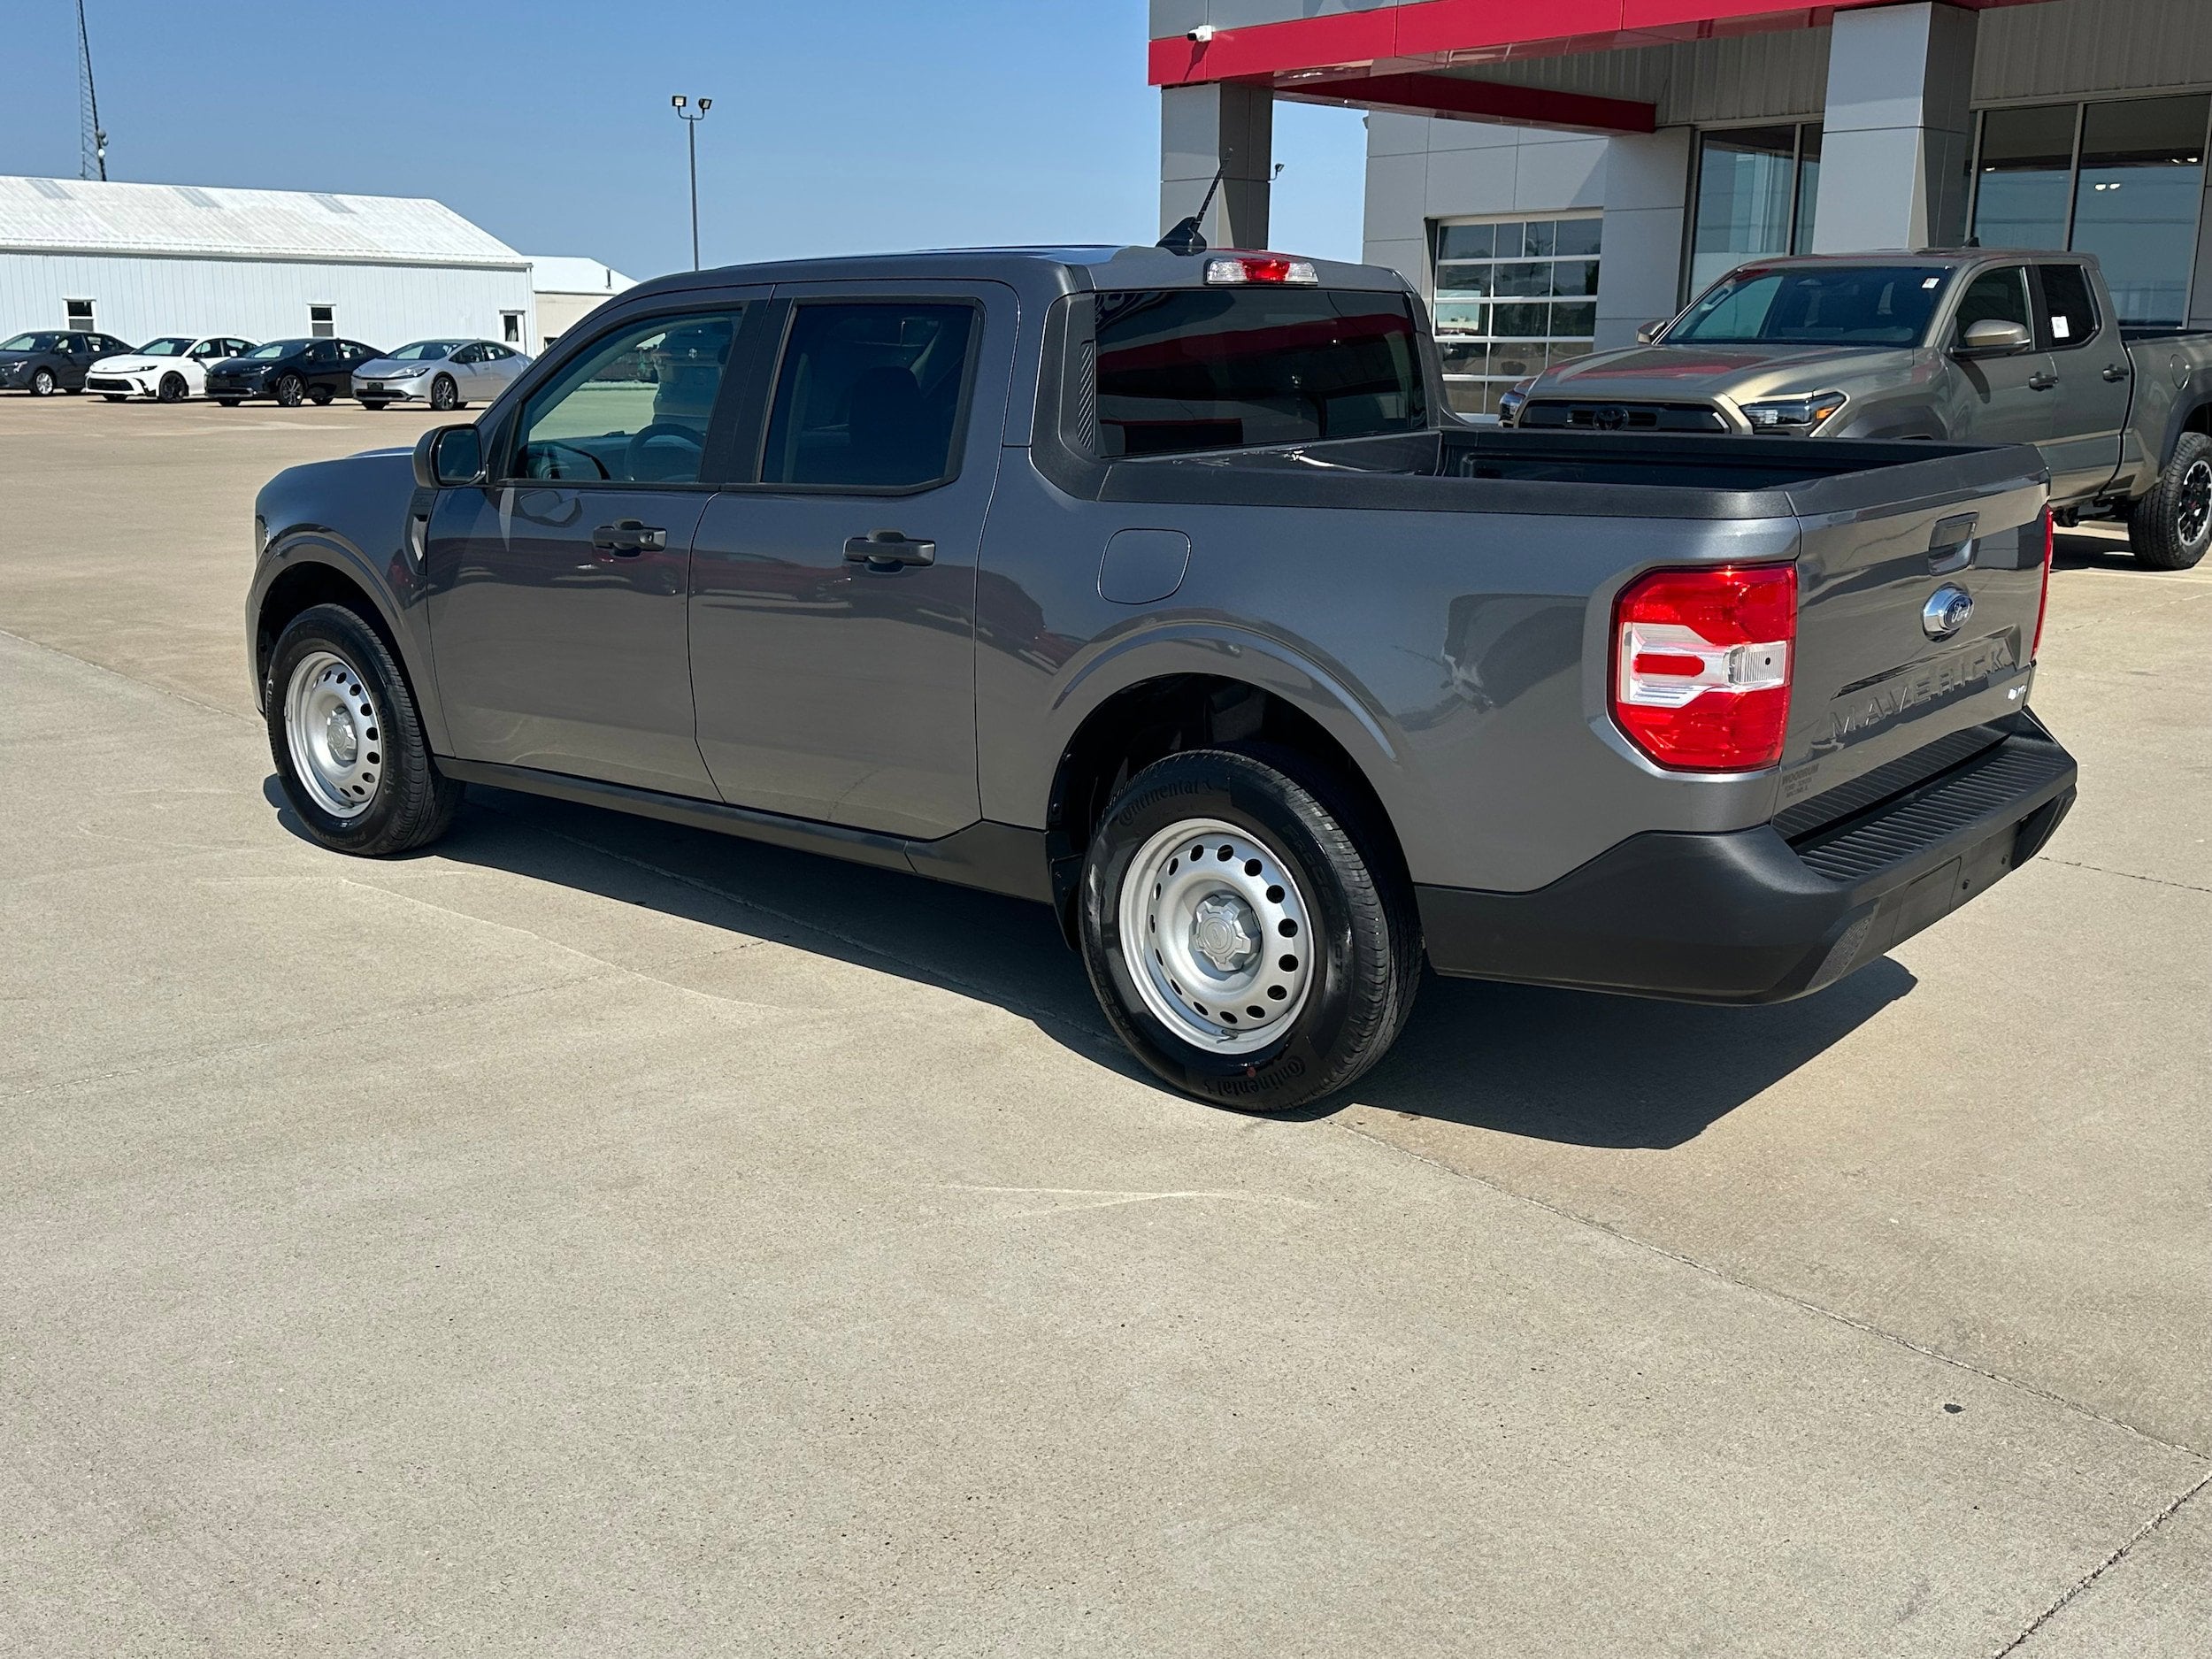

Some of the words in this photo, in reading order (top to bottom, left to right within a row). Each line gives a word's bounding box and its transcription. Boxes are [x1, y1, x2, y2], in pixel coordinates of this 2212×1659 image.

[1829, 642, 2007, 738] MAVERICK
[1118, 780, 1200, 826] Continental
[1217, 1056, 1306, 1096] Continental
